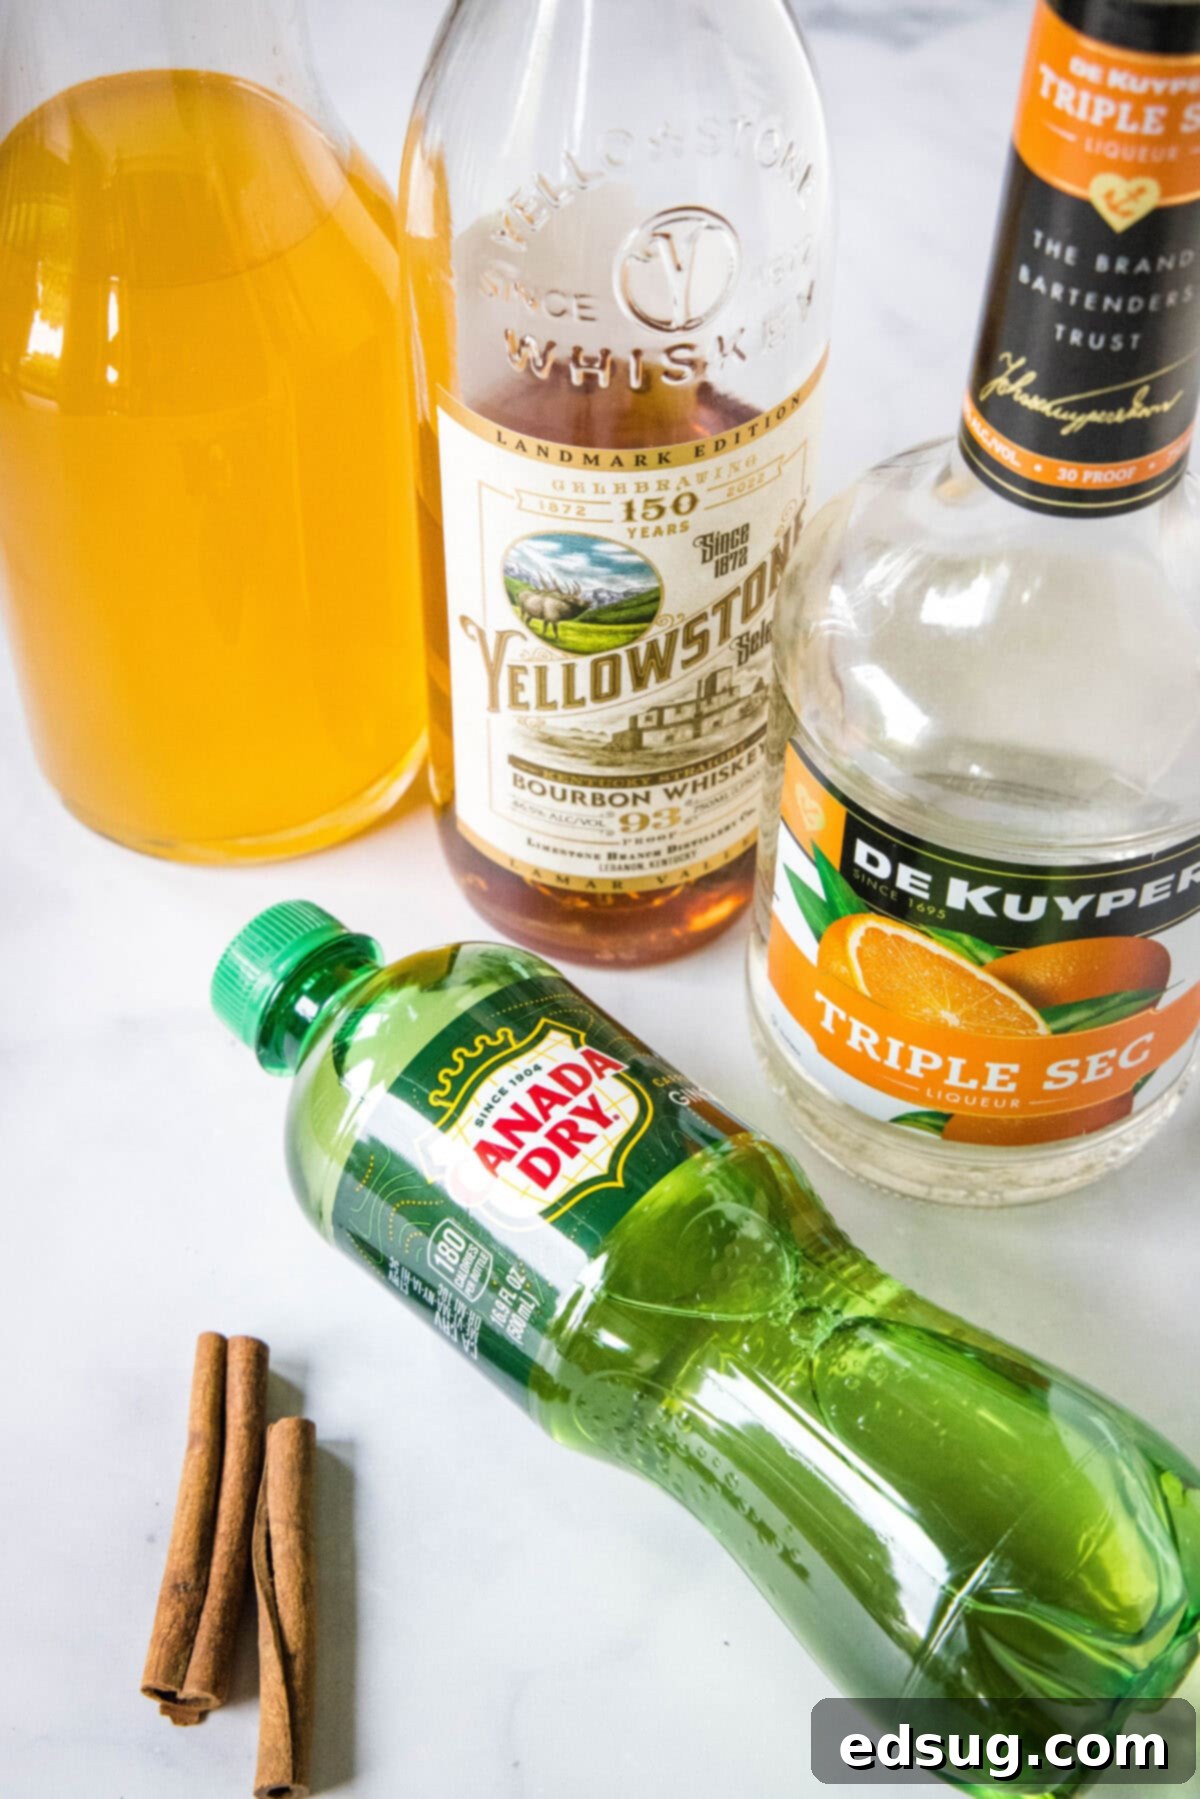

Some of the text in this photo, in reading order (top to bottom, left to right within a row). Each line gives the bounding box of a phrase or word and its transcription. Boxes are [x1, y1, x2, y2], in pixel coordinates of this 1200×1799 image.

[1039, 62, 1168, 135] TRIPLE
[1069, 56, 1200, 96] DE KUYPE
[1084, 137, 1179, 163] LIQUEUR
[489, 114, 814, 252] YELLOWSTON
[1033, 229, 1195, 275] THE BRAND
[1018, 264, 1195, 314] BARTENDERS
[1054, 323, 1143, 351] TRUST
[496, 395, 802, 468] LANDMARK EDITION
[538, 472, 767, 523] 1872 150 2022
[1056, 467, 1078, 483] 30
[1082, 466, 1136, 484] PROOF
[627, 519, 690, 540] YEARS
[692, 522, 750, 565] Since
[713, 546, 749, 579] 1872
[729, 619, 773, 668] Sele
[512, 772, 651, 809] BOURBON
[619, 806, 682, 834] 93
[622, 831, 677, 846] PROOF
[510, 836, 751, 890] LAMAR VALLE
[852, 837, 1200, 923] DE KUYPER
[852, 870, 947, 921] SINCE 1695
[814, 990, 1020, 1093] TRIPLE
[1042, 1032, 1155, 1092] SEC
[474, 1062, 544, 1128] SINCE 1904
[925, 1087, 1021, 1109] LIQUEUR
[456, 1046, 627, 1196] ANADA
[433, 1228, 467, 1274] 180
[454, 1243, 480, 1289] CALORIES
[470, 1251, 490, 1282] BOTTLE
[490, 1266, 527, 1329] 16.9 FL OZ
